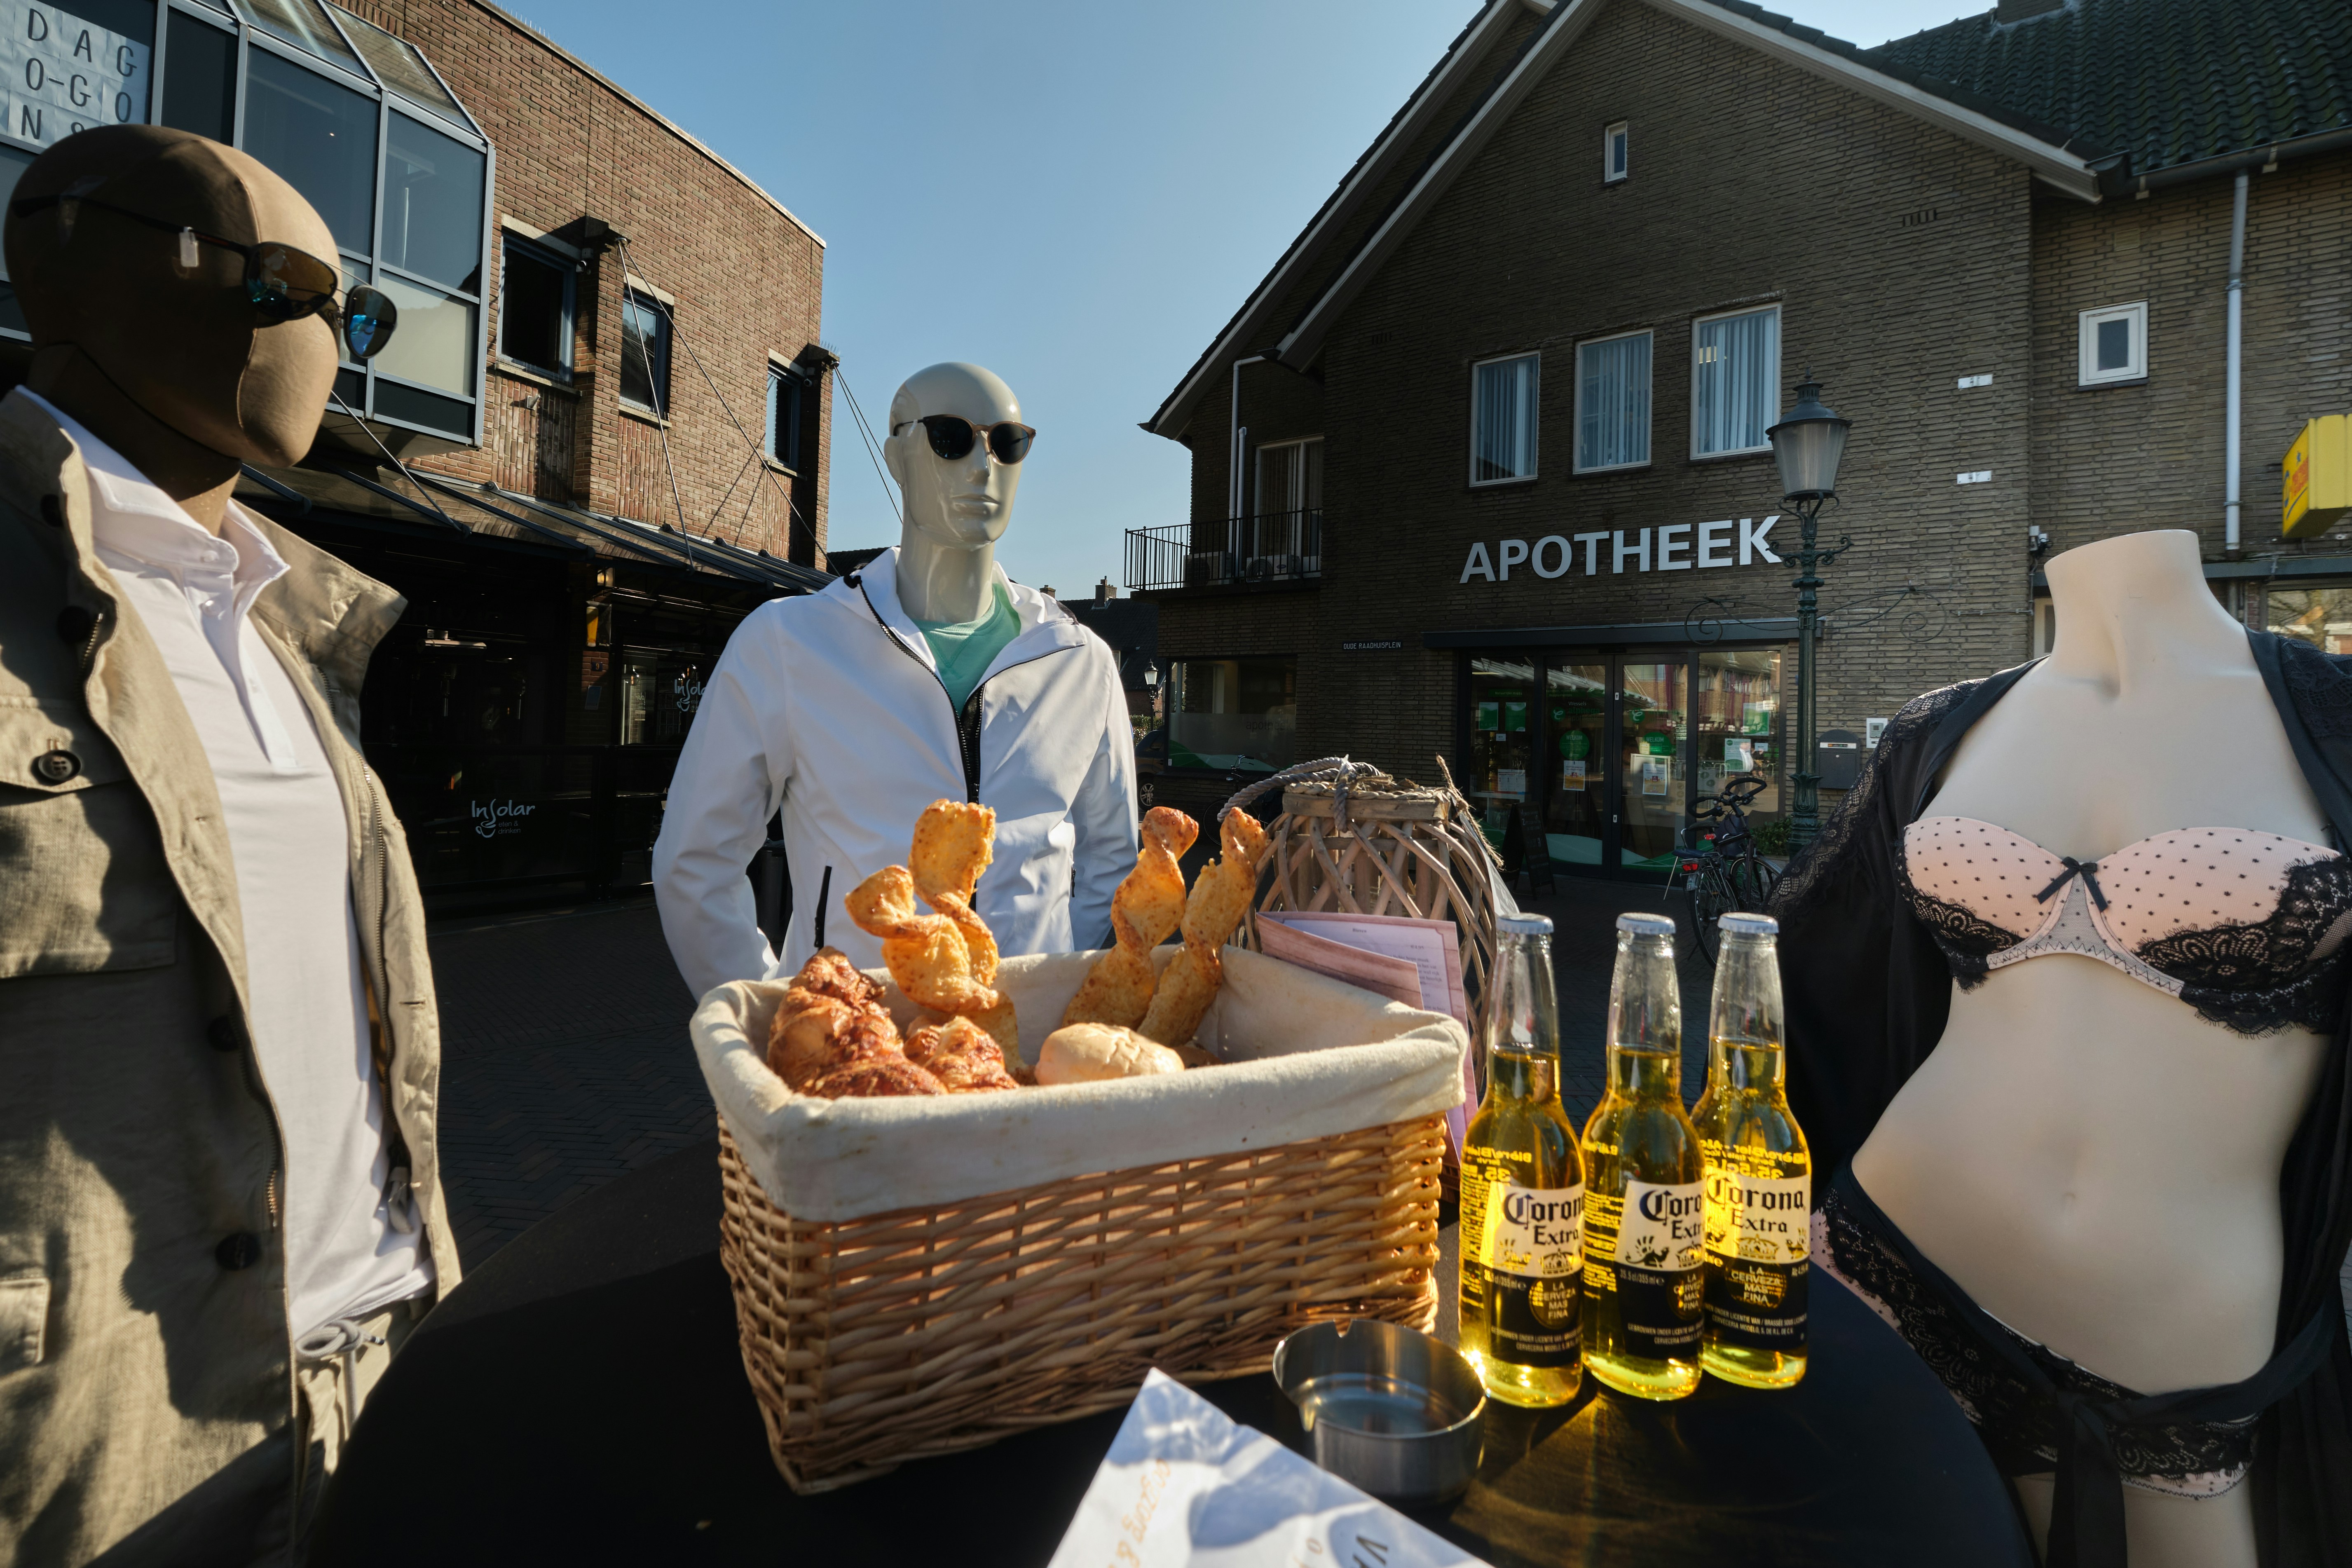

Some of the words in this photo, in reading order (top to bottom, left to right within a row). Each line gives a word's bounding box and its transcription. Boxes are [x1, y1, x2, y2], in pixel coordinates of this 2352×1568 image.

[1459, 516, 1783, 584] APOTHEEK
[1706, 1174, 1804, 1211] Corona
[1504, 1191, 1585, 1230] Coron
[1731, 1209, 1787, 1232] Extra
[1534, 1225, 1579, 1245] Extra
[1750, 1266, 1764, 1275] LA
[1687, 1273, 1696, 1282] LA
[1731, 1270, 1781, 1285] CERVEZA
[1553, 1282, 1565, 1291] LA
[1744, 1282, 1768, 1294] MAS
[1684, 1291, 1698, 1301] MAS
[1743, 1292, 1768, 1303] FINA
[1548, 1300, 1567, 1309] MAS
[1683, 1301, 1698, 1311] FINA
[1548, 1310, 1568, 1320] FINA
[1715, 1305, 1729, 1318] ONDER
[1730, 1311, 1750, 1323] LICENTIE
[1712, 1315, 1738, 1329] CERVECERIA
[1628, 1322, 1656, 1335] GEBROUWEN
[1656, 1327, 1671, 1336] ONDER
[1654, 1336, 1680, 1345] CERVECERIA
